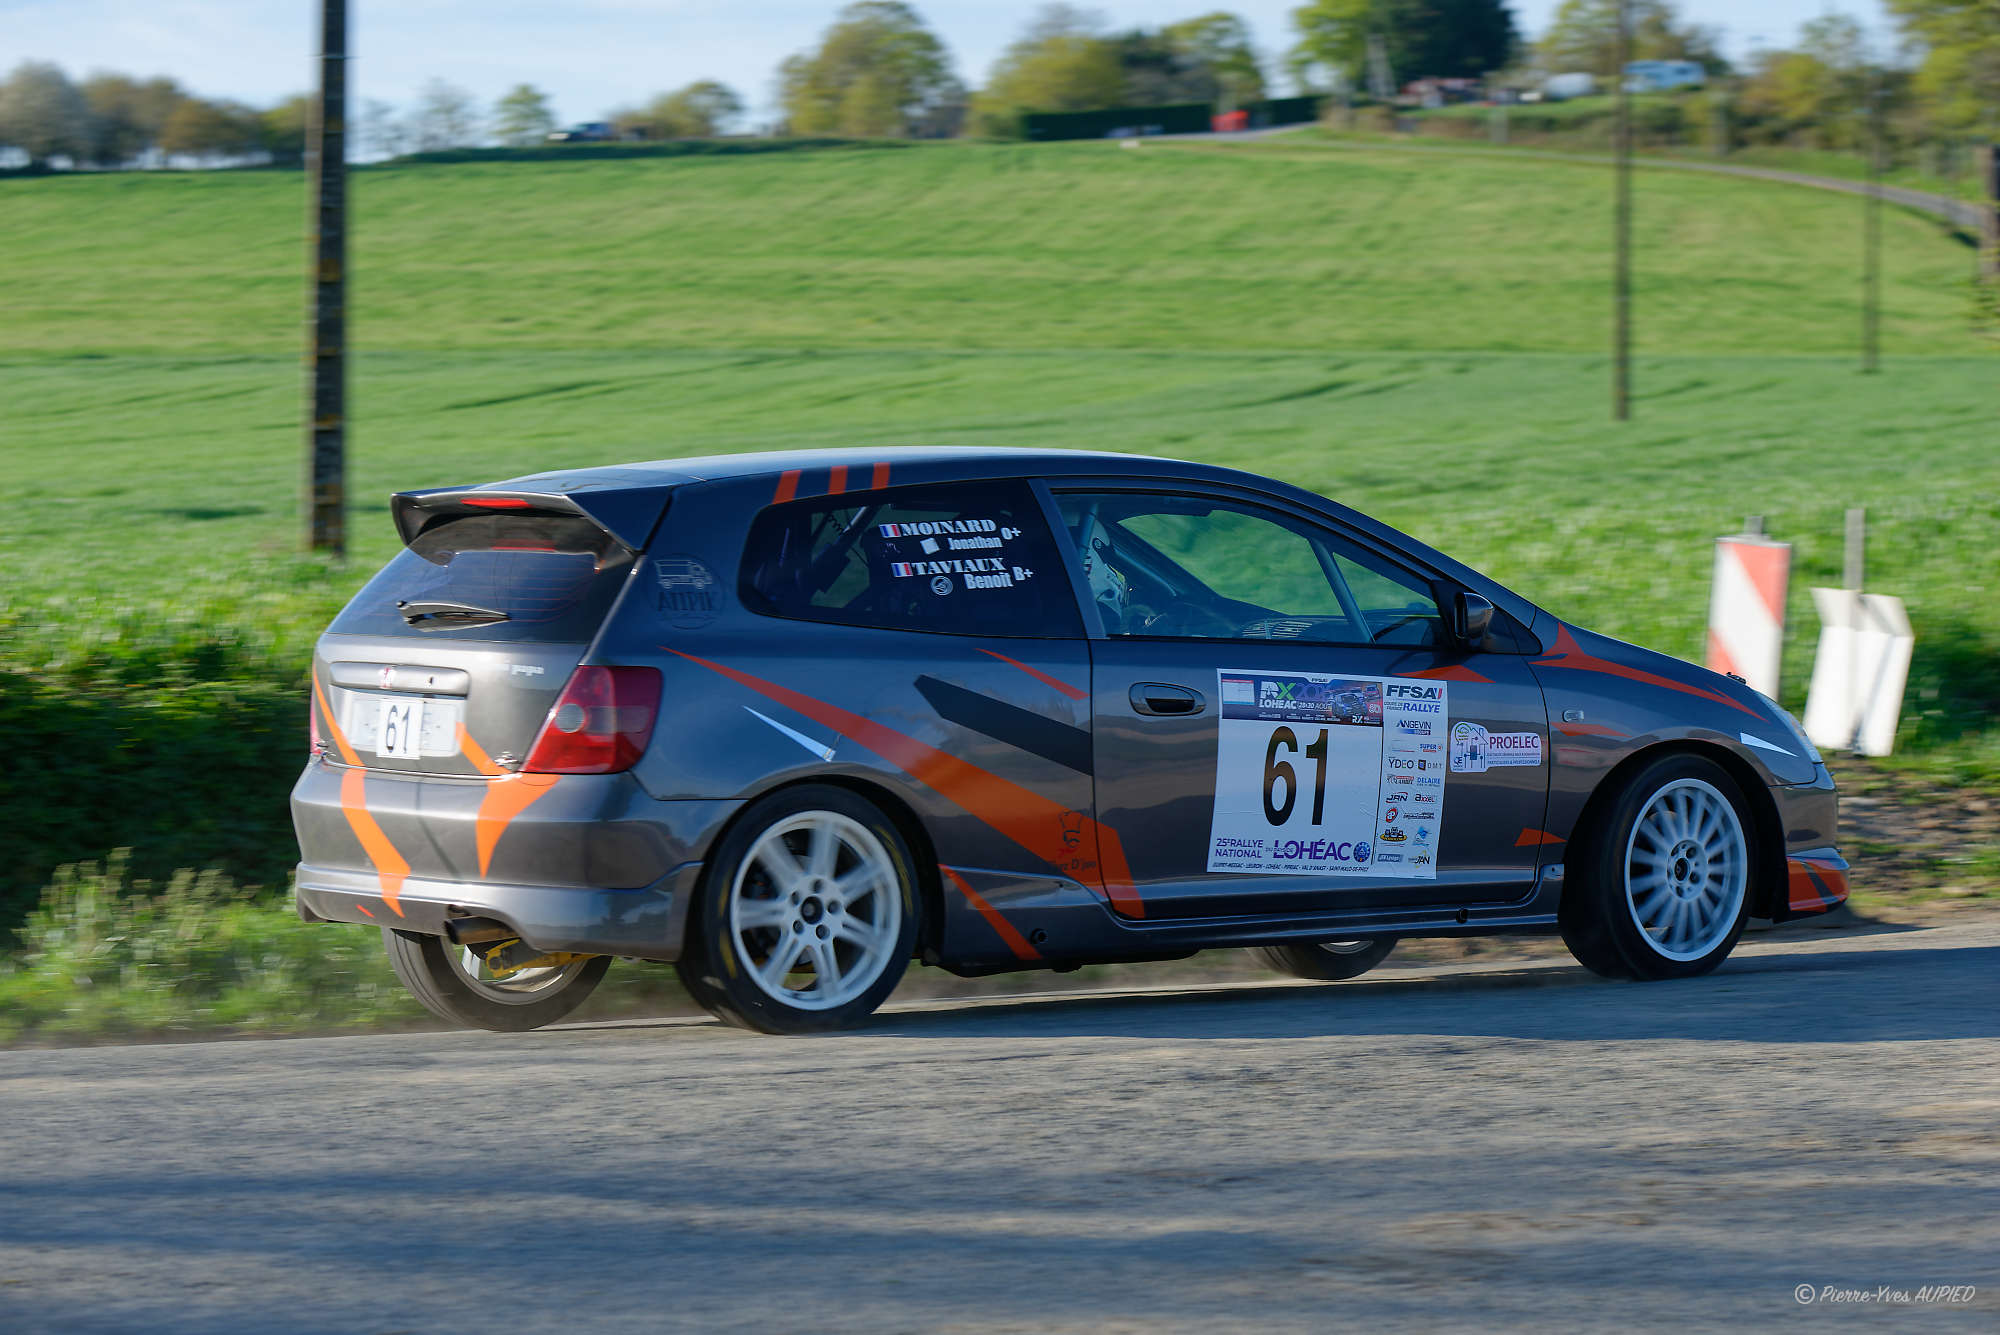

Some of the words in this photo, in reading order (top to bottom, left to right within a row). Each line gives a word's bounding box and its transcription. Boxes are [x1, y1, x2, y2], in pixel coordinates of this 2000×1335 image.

[899, 519, 997, 537] MOINARD
[947, 535, 1003, 551] Jonathan
[911, 557, 1007, 576] TAVIAUX
[1012, 566, 1034, 581] B+
[1386, 684, 1437, 700] FFSA
[1402, 702, 1441, 714] RALLYE
[385, 704, 411, 755] 61
[1395, 719, 1432, 730] ANGEVIN
[1489, 735, 1539, 749] PROELEC
[1388, 759, 1415, 769] YDEO
[1263, 725, 1330, 827] 61
[1230, 839, 1264, 848] RALLYE
[1272, 838, 1353, 861] LOHÉAC
[1215, 848, 1263, 859] NATIONAL
